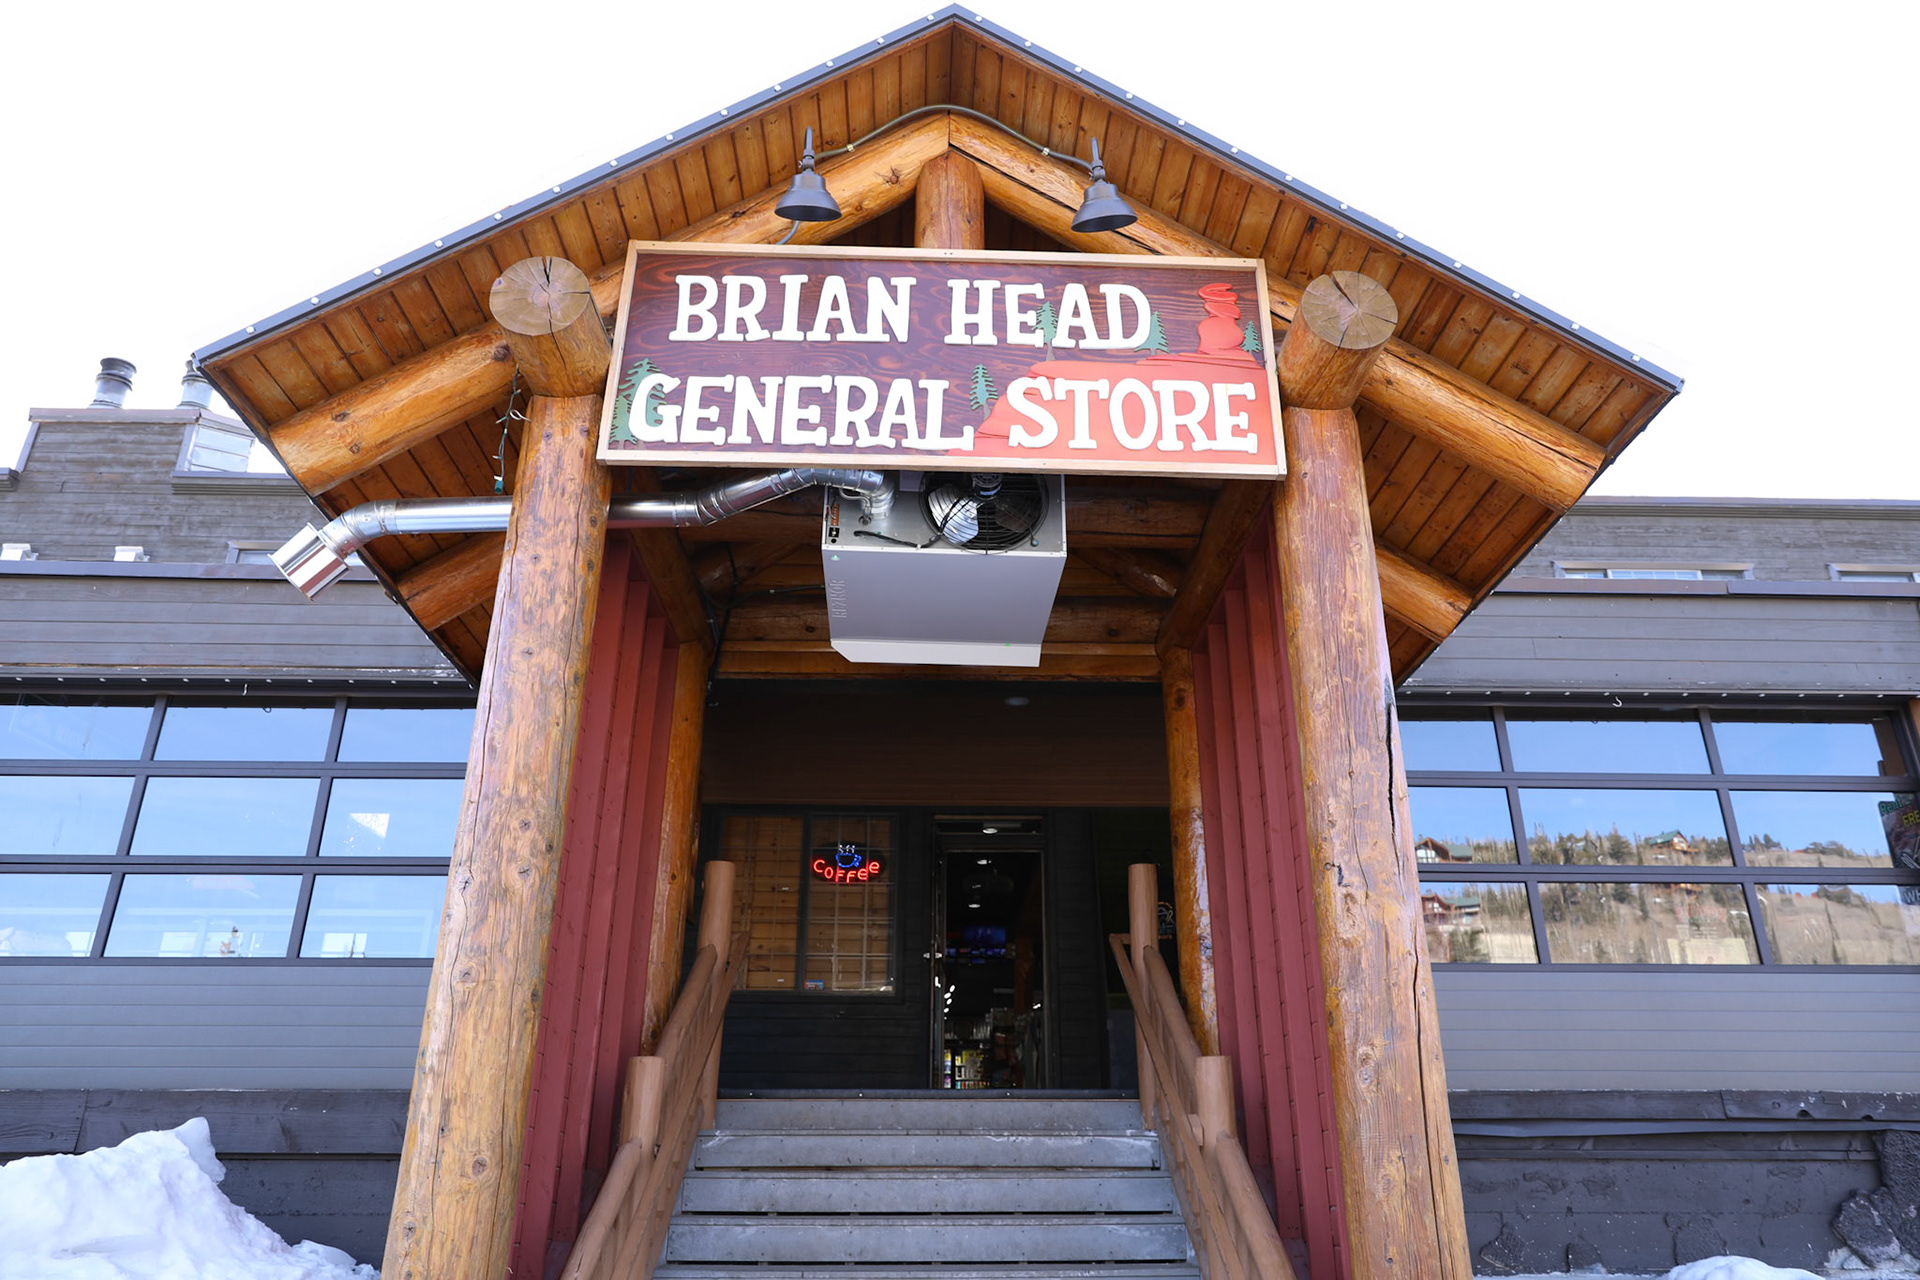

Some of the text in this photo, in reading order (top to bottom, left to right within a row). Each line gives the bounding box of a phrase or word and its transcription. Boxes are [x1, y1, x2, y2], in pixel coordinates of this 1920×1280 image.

[668, 273, 1152, 350] BRIAN HEAD
[628, 372, 1258, 454] GENERAL STORE
